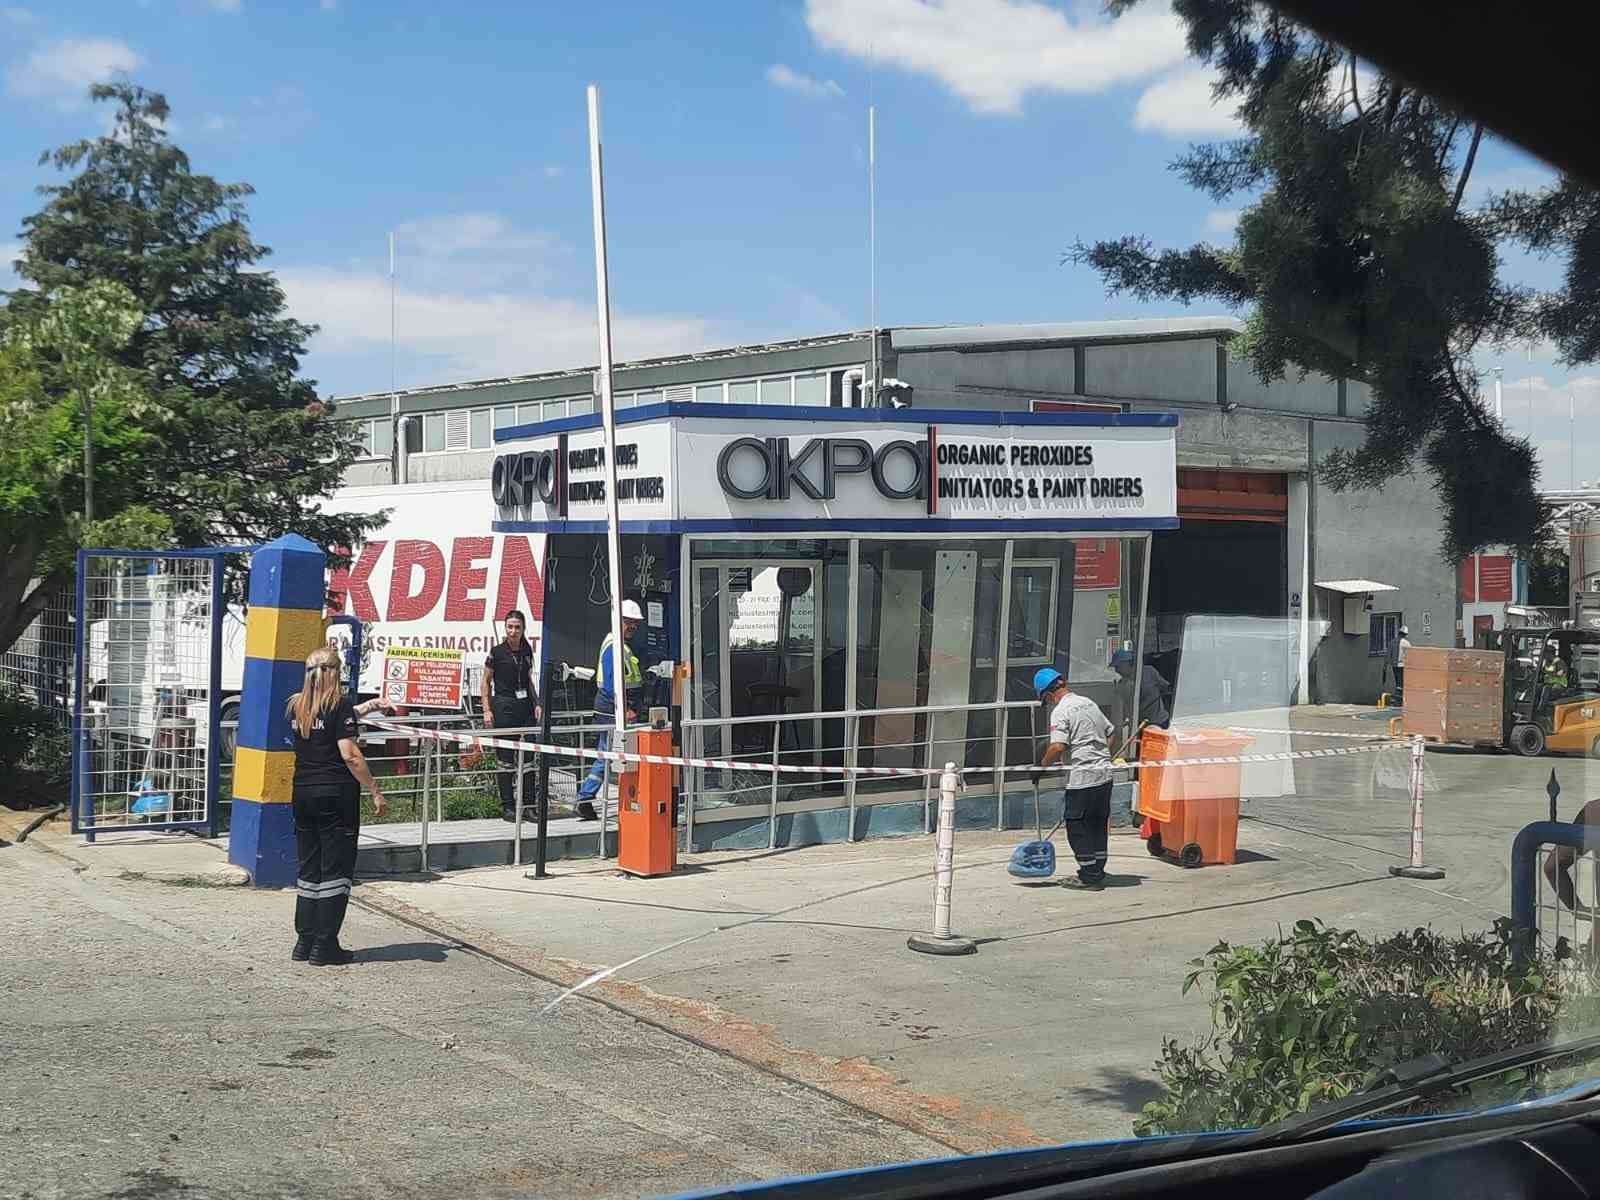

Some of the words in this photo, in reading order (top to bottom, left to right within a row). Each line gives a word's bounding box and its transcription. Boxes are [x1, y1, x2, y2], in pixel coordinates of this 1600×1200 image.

[937, 444, 1005, 466] ORGANIC
[1010, 445, 1093, 466] PEROXIDES
[938, 477, 1024, 498] INITIATORS
[1027, 478, 1039, 498] &
[1042, 477, 1086, 498] PAINT
[1090, 477, 1144, 498] DRIERS
